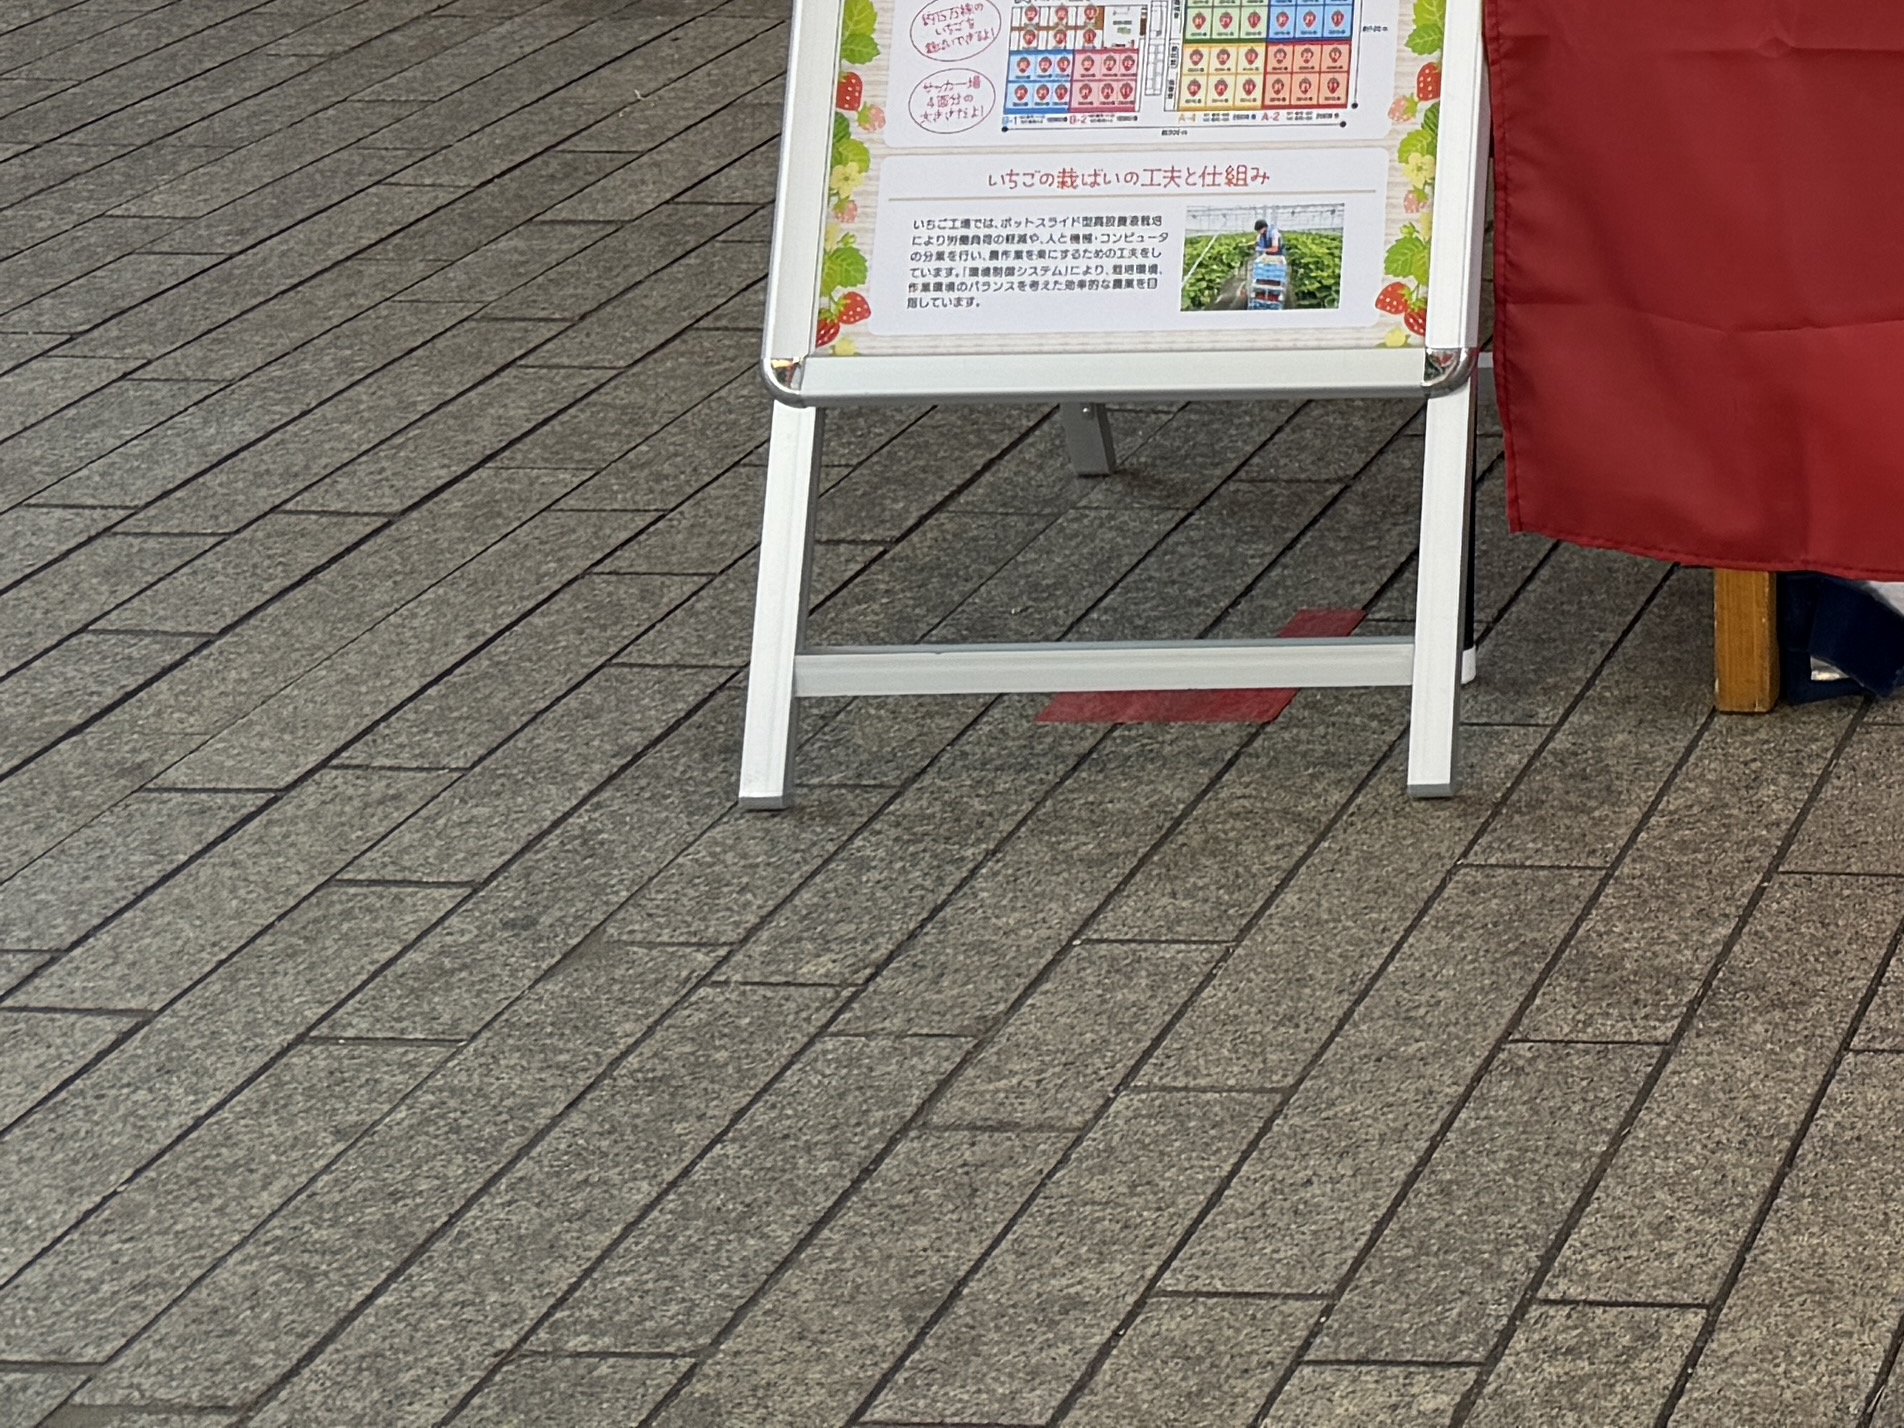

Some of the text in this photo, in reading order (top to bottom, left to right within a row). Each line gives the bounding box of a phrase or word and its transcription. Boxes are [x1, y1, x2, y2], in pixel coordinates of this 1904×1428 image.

[988, 165, 1270, 190] いちごの栽ばいの工夫と仕組み
